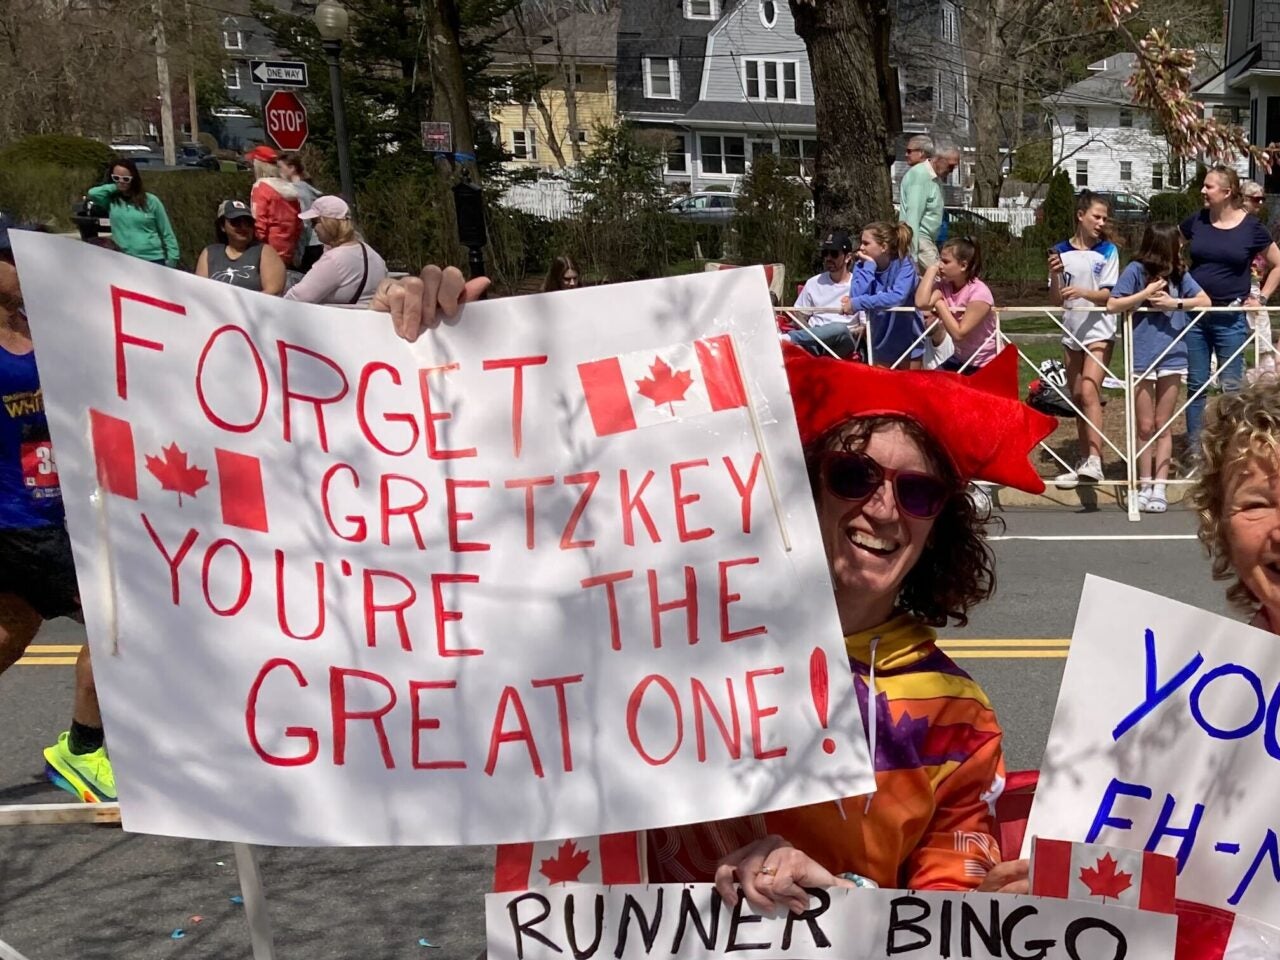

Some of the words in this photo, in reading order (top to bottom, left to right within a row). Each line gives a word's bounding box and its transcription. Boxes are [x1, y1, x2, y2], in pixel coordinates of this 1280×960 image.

[266, 68, 282, 79] ONE
[284, 68, 300, 79] WAY
[269, 108, 305, 132] STOP
[111, 284, 549, 461] FORGET
[320, 452, 763, 553] GRETZKEY
[140, 512, 484, 658] YOU'RE
[580, 556, 769, 652] THE
[246, 657, 584, 778] GREAT
[626, 645, 839, 767] ONE!
